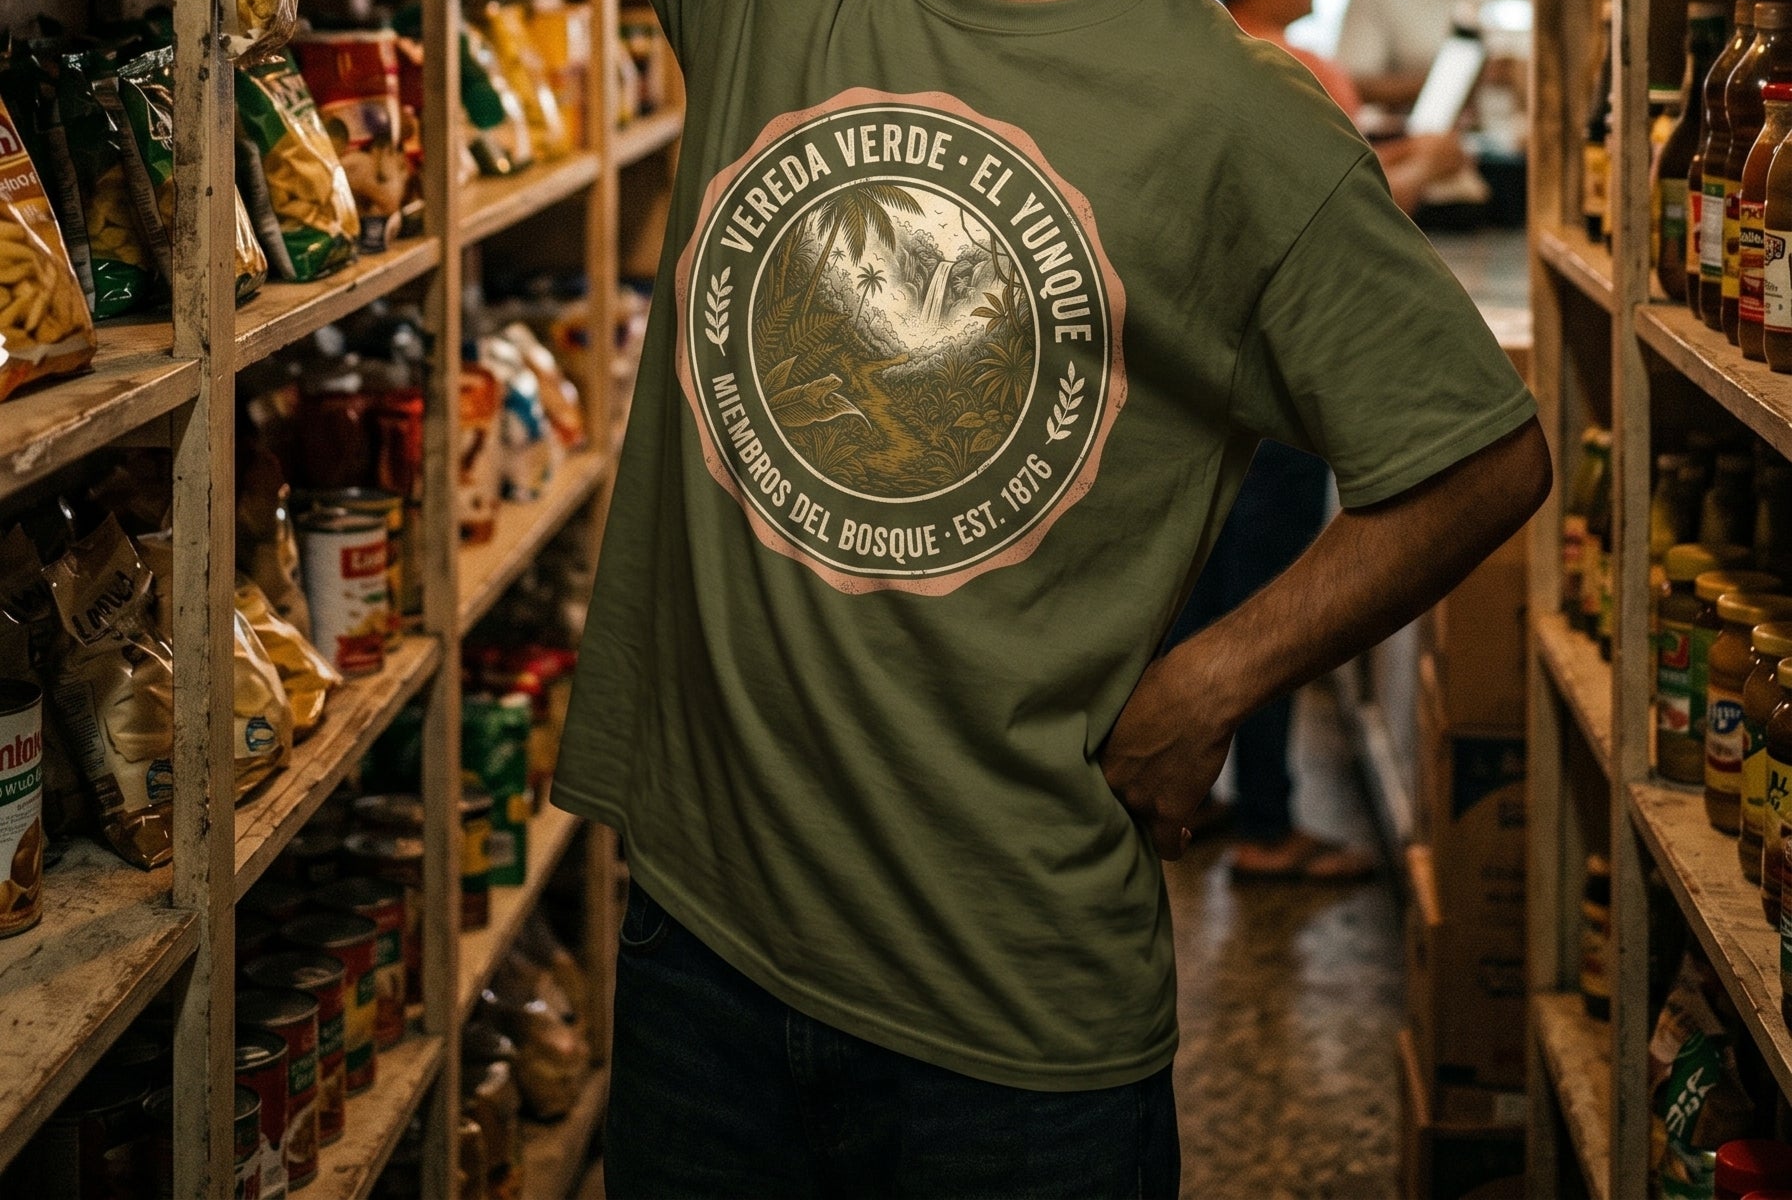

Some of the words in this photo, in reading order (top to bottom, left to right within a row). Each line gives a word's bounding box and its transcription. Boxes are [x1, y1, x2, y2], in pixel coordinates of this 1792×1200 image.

[720, 142, 832, 254] VEREDA
[833, 123, 953, 171] VERDE
[969, 153, 1014, 207] EL
[1009, 191, 1092, 343] YUNQUE
[711, 372, 792, 507] MIEMBROS
[788, 492, 831, 543] DEL
[837, 518, 941, 565] BOSQUE
[952, 500, 1006, 545] EST.
[1000, 453, 1052, 512] 1876
